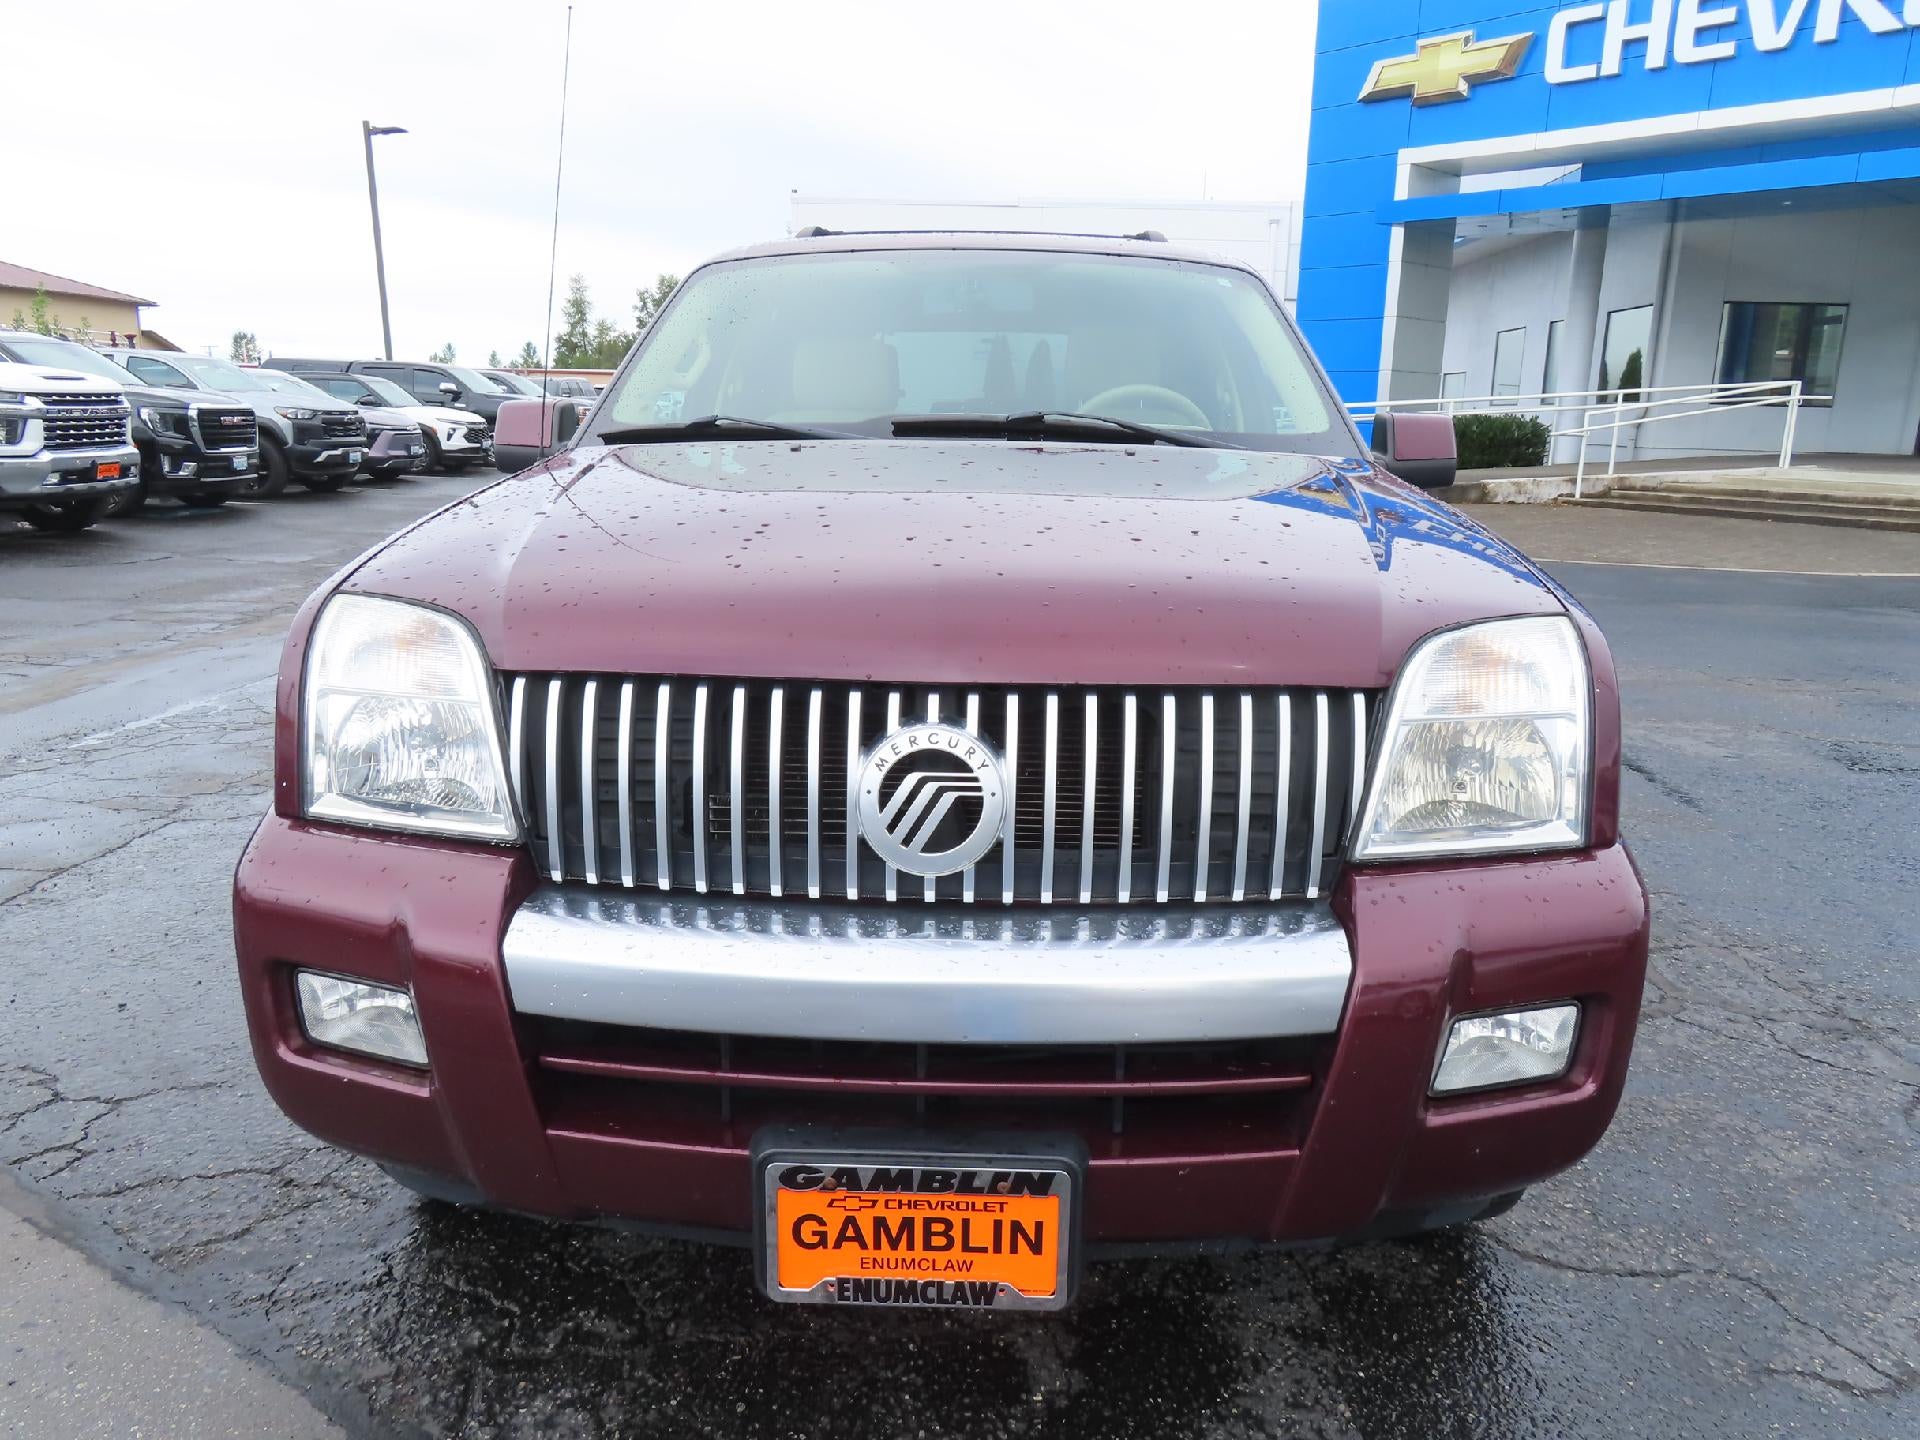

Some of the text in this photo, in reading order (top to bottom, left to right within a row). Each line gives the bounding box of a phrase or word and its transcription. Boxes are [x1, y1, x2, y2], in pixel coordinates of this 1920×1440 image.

[1544, 0, 1920, 84] CHEV
[874, 732, 989, 772] MERCURY
[778, 1165, 1055, 1196] GAMBLIN
[884, 1197, 1008, 1213] CHEVROLET
[791, 1213, 1044, 1256] GAMBLIN
[859, 1256, 974, 1273] ENUMCLAW
[837, 1278, 998, 1306] ENUMCLAW
